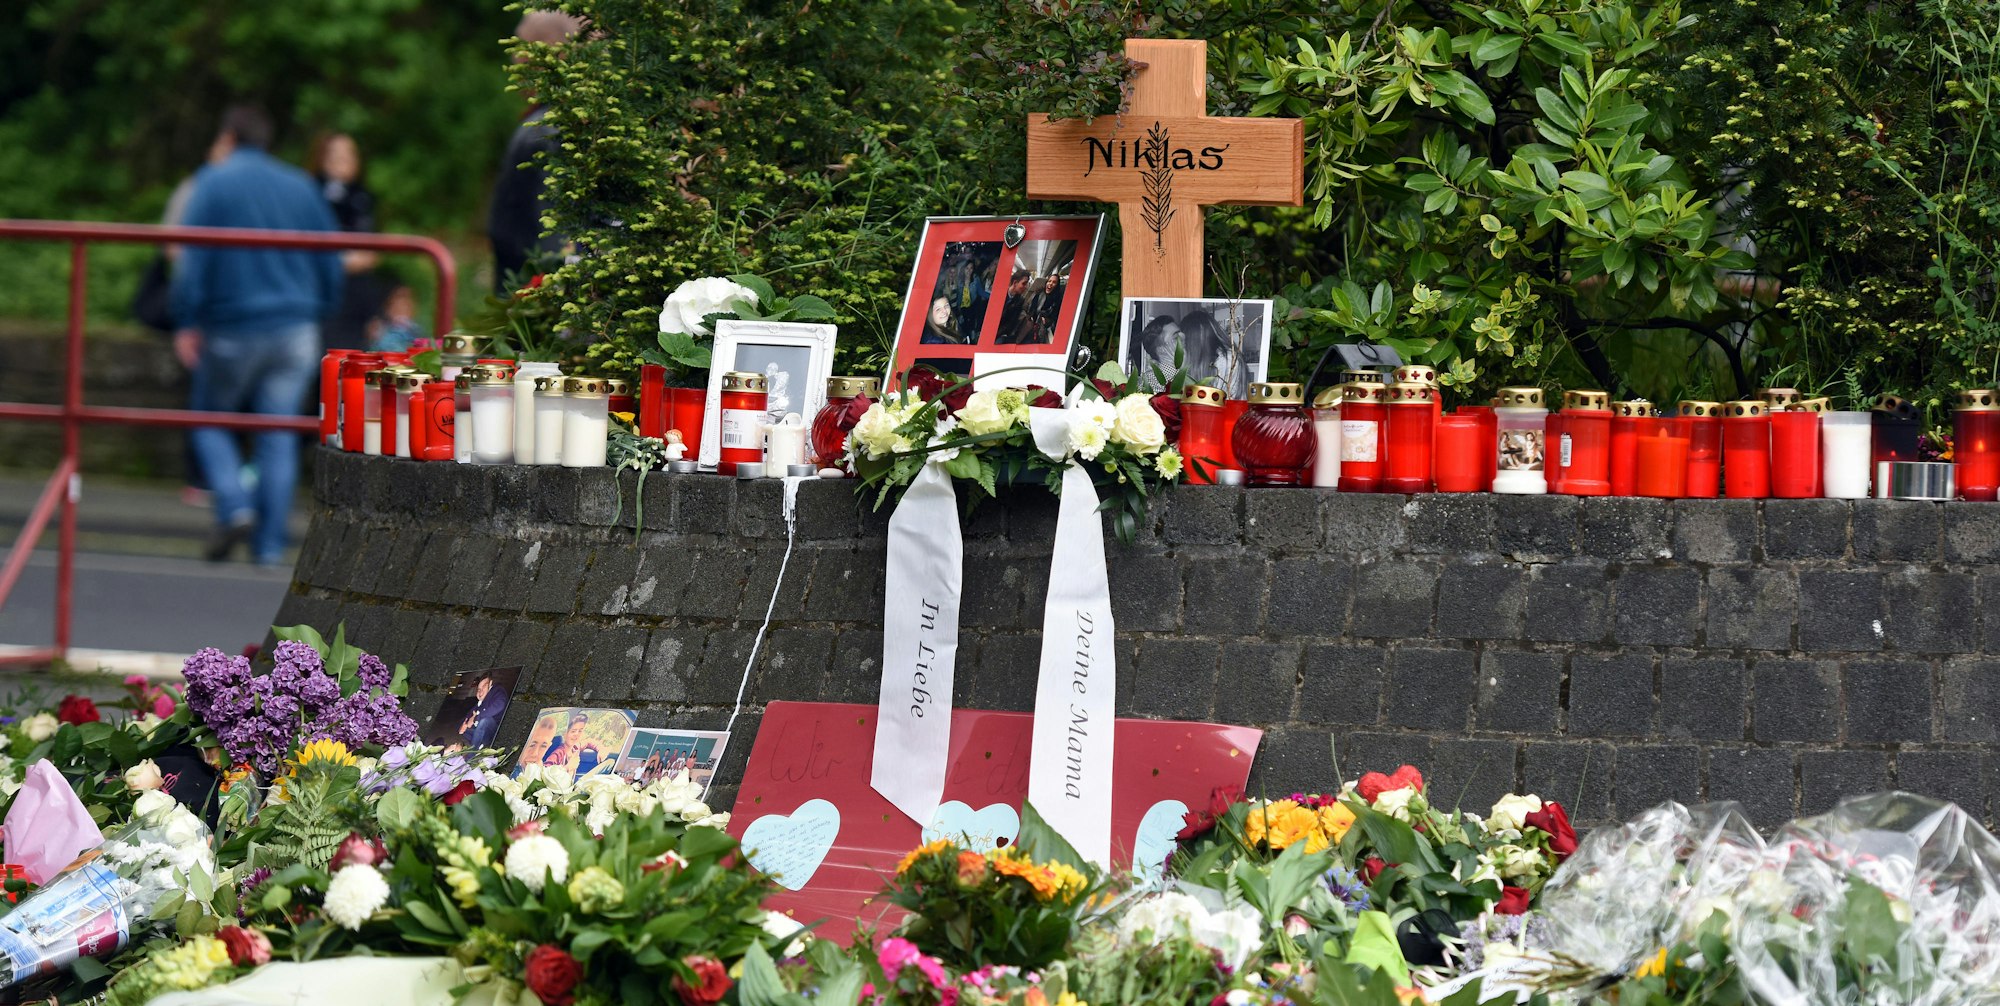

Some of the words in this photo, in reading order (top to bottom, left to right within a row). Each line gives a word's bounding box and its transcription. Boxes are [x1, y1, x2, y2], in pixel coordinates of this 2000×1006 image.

[1081, 136, 1230, 177] Niklas
[922, 598, 940, 631] In
[910, 641, 936, 719] Liebe
[1072, 609, 1093, 694] Deine
[770, 719, 844, 783] Wir
[1065, 703, 1089, 800] Mama
